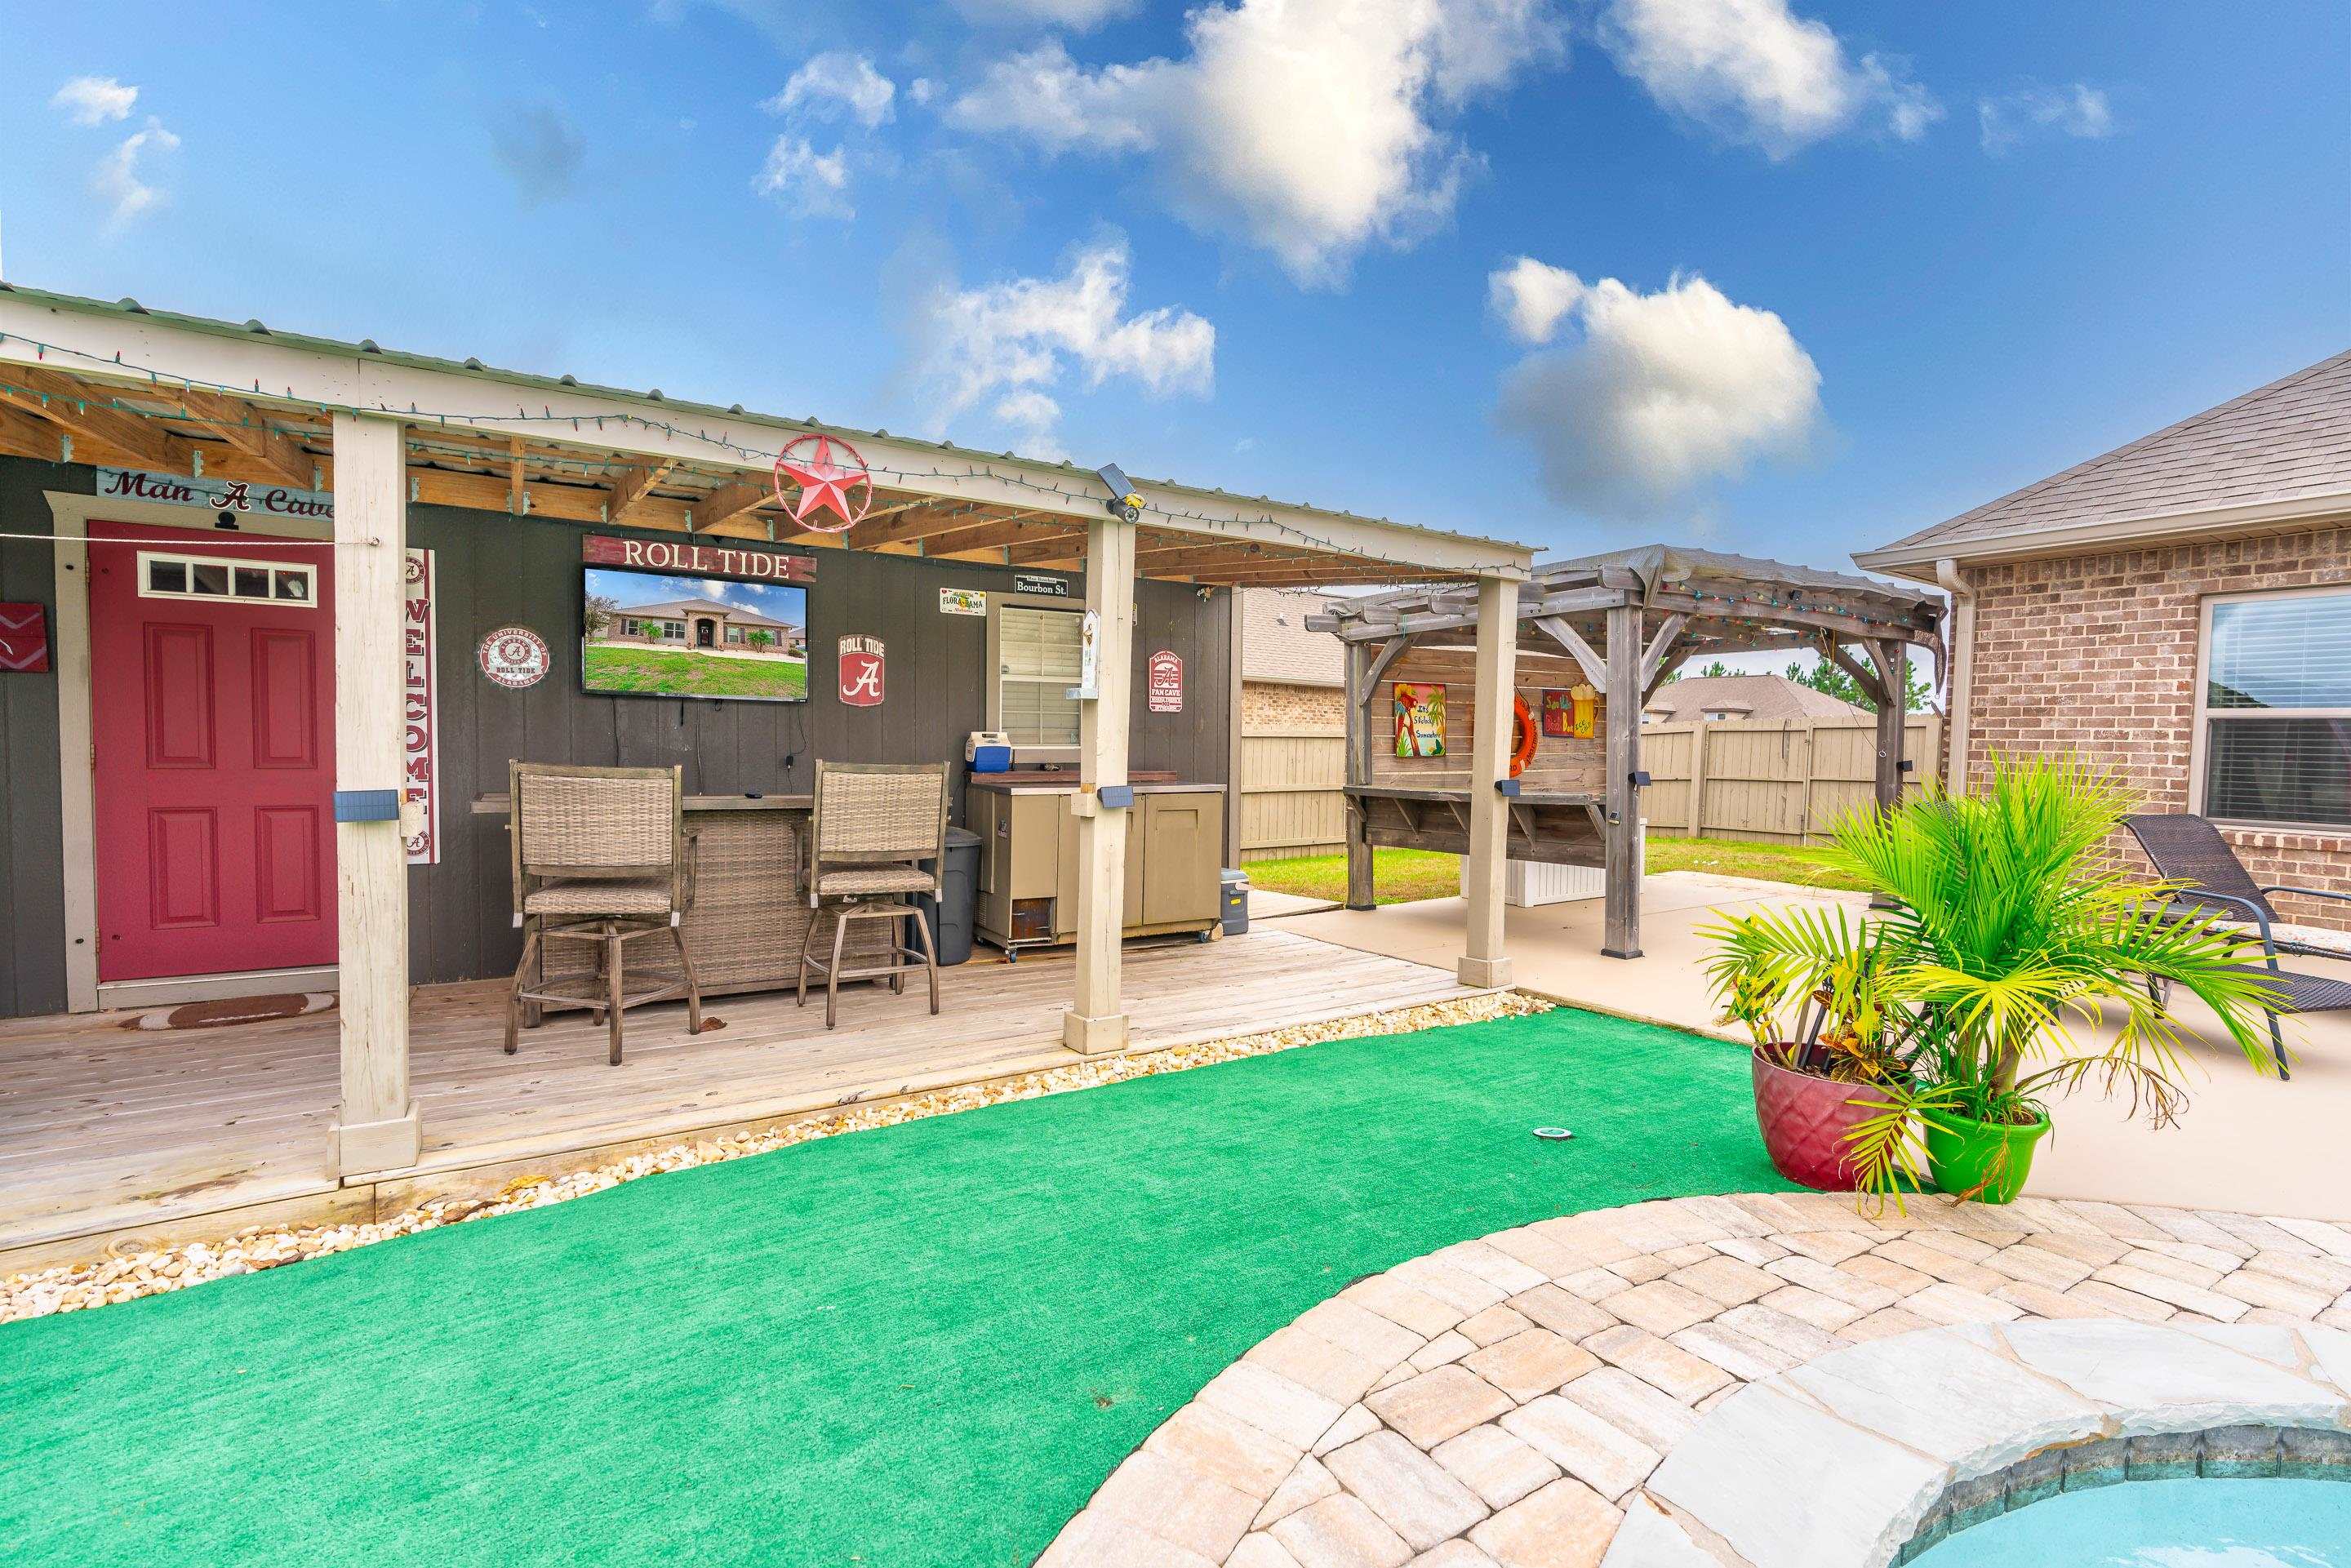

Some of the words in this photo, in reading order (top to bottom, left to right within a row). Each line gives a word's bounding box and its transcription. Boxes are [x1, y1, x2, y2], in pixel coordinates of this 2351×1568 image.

[104, 471, 193, 502] Man
[264, 489, 335, 519] Cave
[622, 540, 708, 571] ROLL
[718, 548, 790, 580] TIDE
[1016, 581, 1053, 594] Bourbon
[1055, 584, 1067, 596] St.
[482, 641, 493, 654] THE
[492, 630, 540, 644] UNIVERSITY
[540, 646, 548, 656] OF
[839, 637, 862, 655] ROLL
[864, 637, 885, 658] TIDE
[1154, 655, 1178, 664] ALABAMA
[496, 675, 536, 686] ALABAMA
[842, 660, 881, 697] A
[1151, 688, 1164, 696] FAN
[1164, 689, 1181, 697] CAVE
